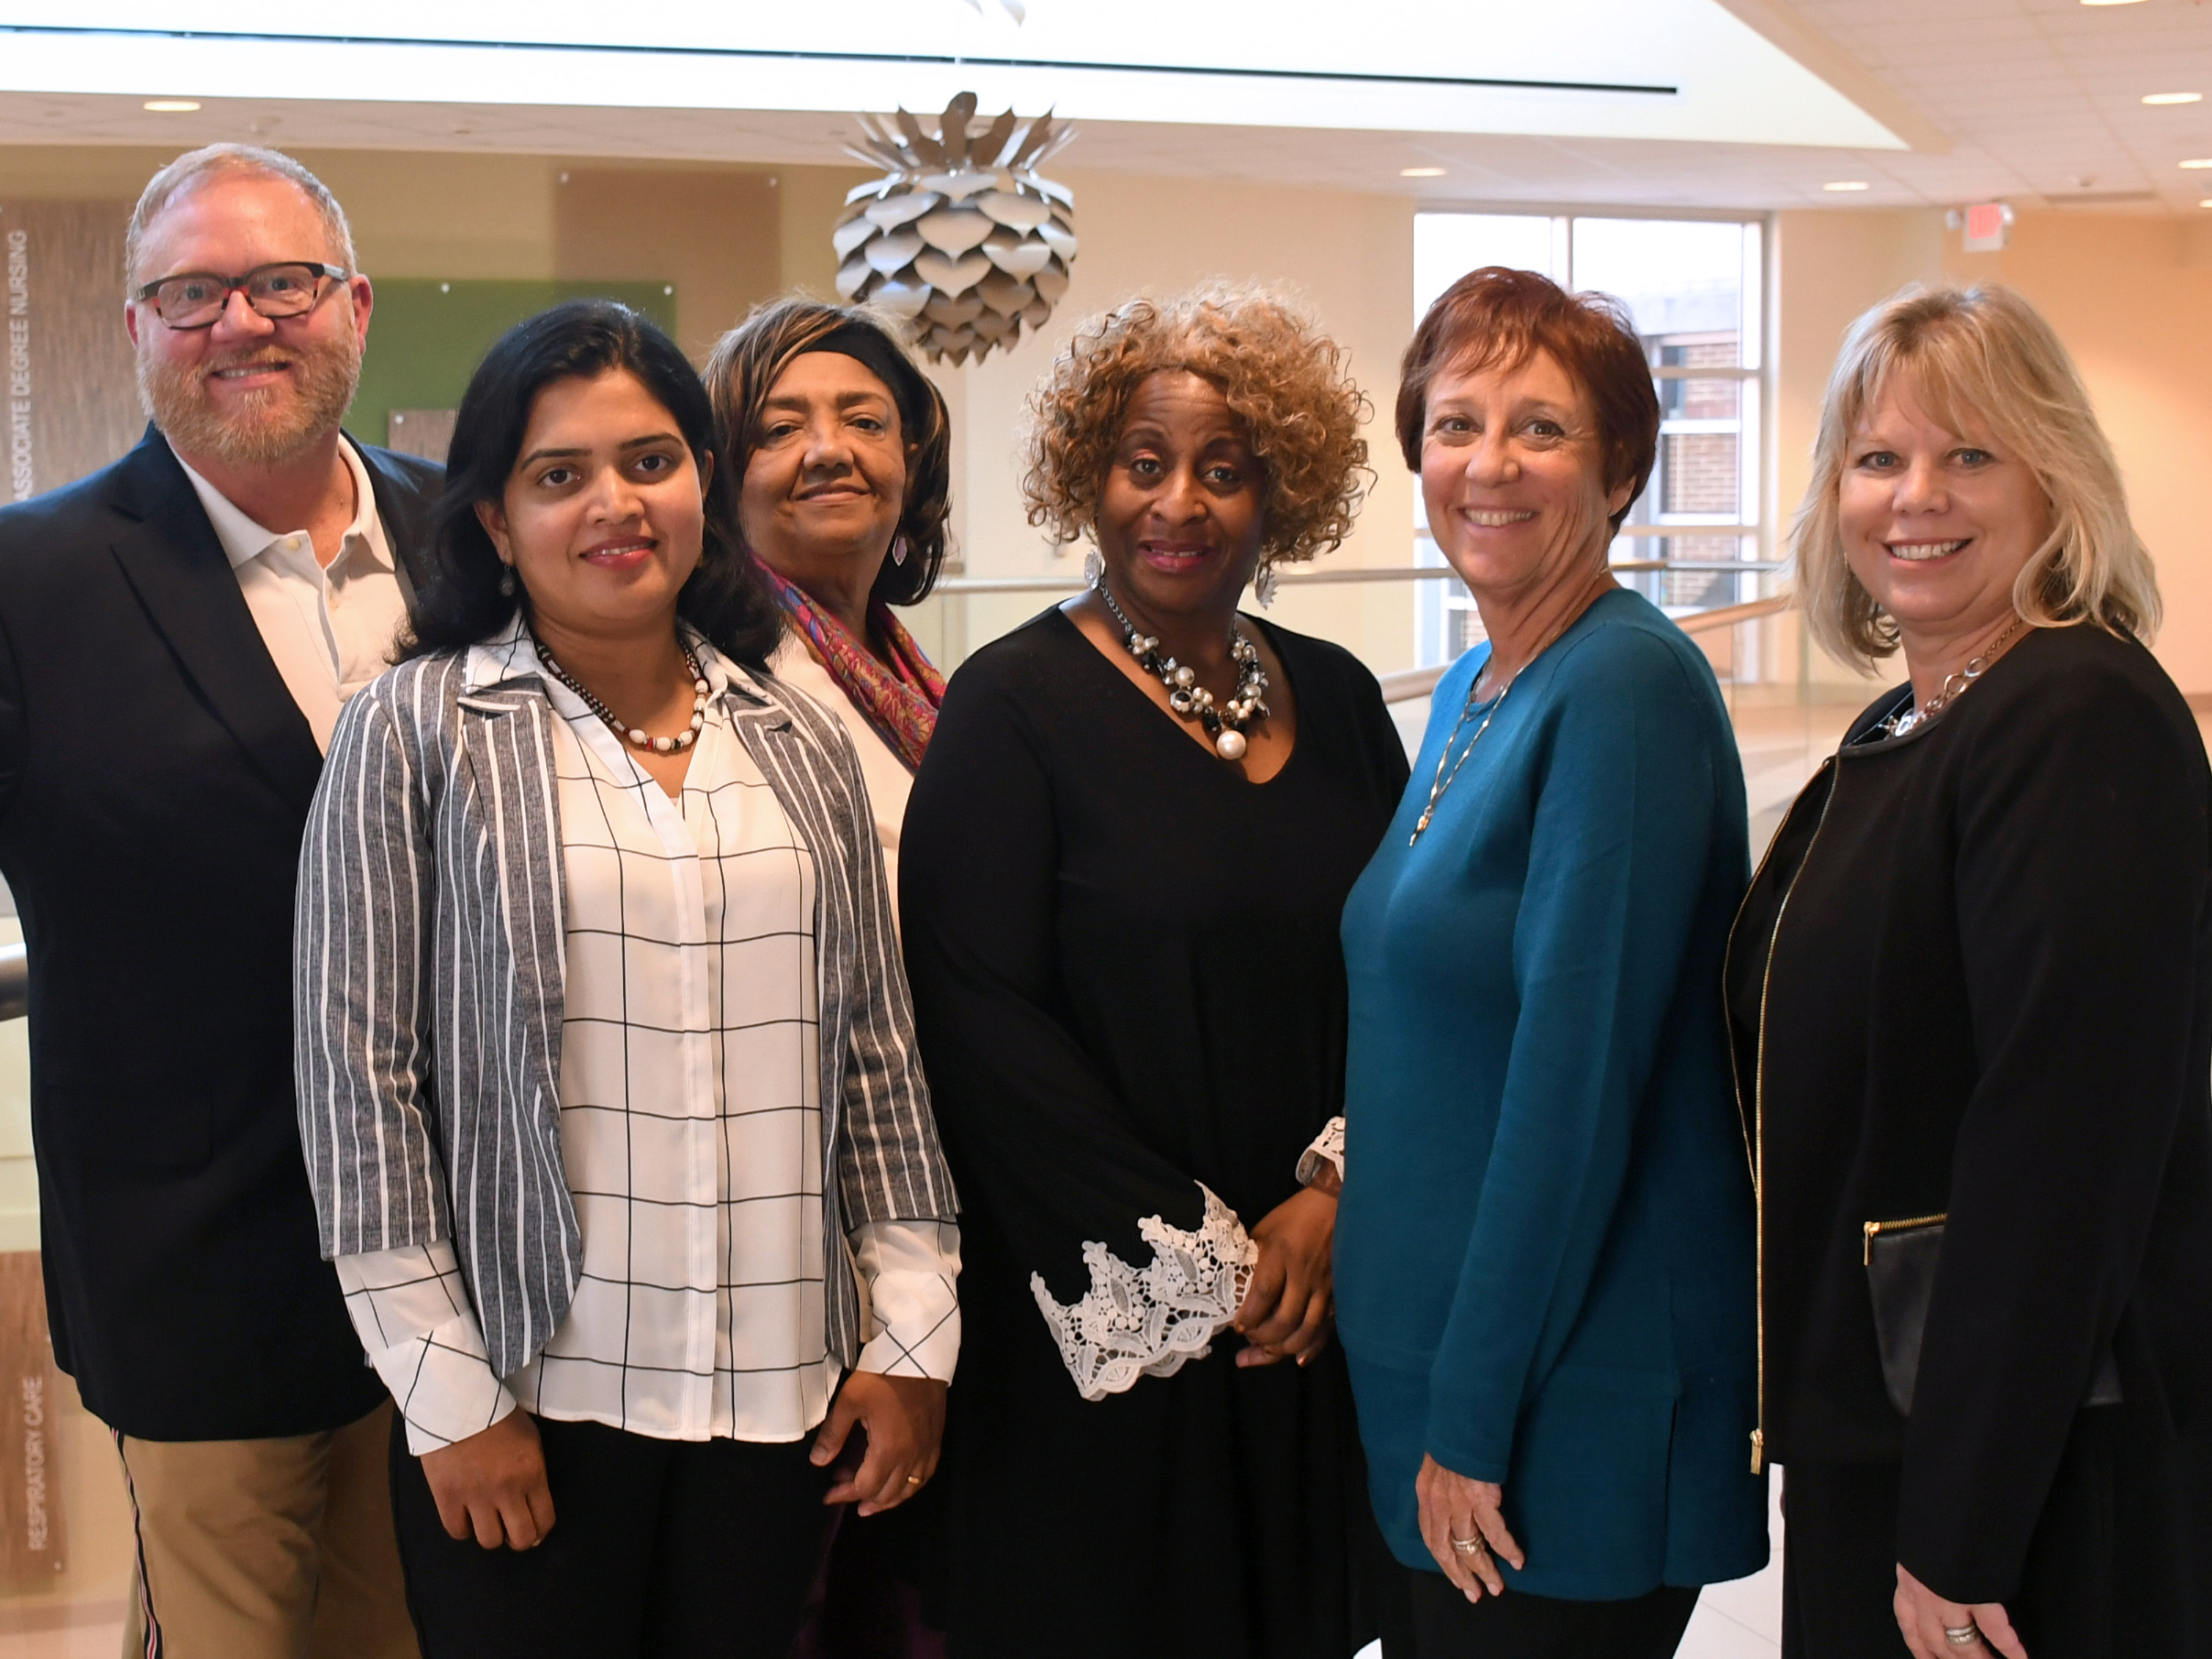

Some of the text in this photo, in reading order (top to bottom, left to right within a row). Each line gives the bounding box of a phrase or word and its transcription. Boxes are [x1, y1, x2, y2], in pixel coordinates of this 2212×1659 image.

[7, 231, 32, 501] ASSOCIATE DEGREE NURSING
[22, 1377, 48, 1550] RESPIRATORY CARE
